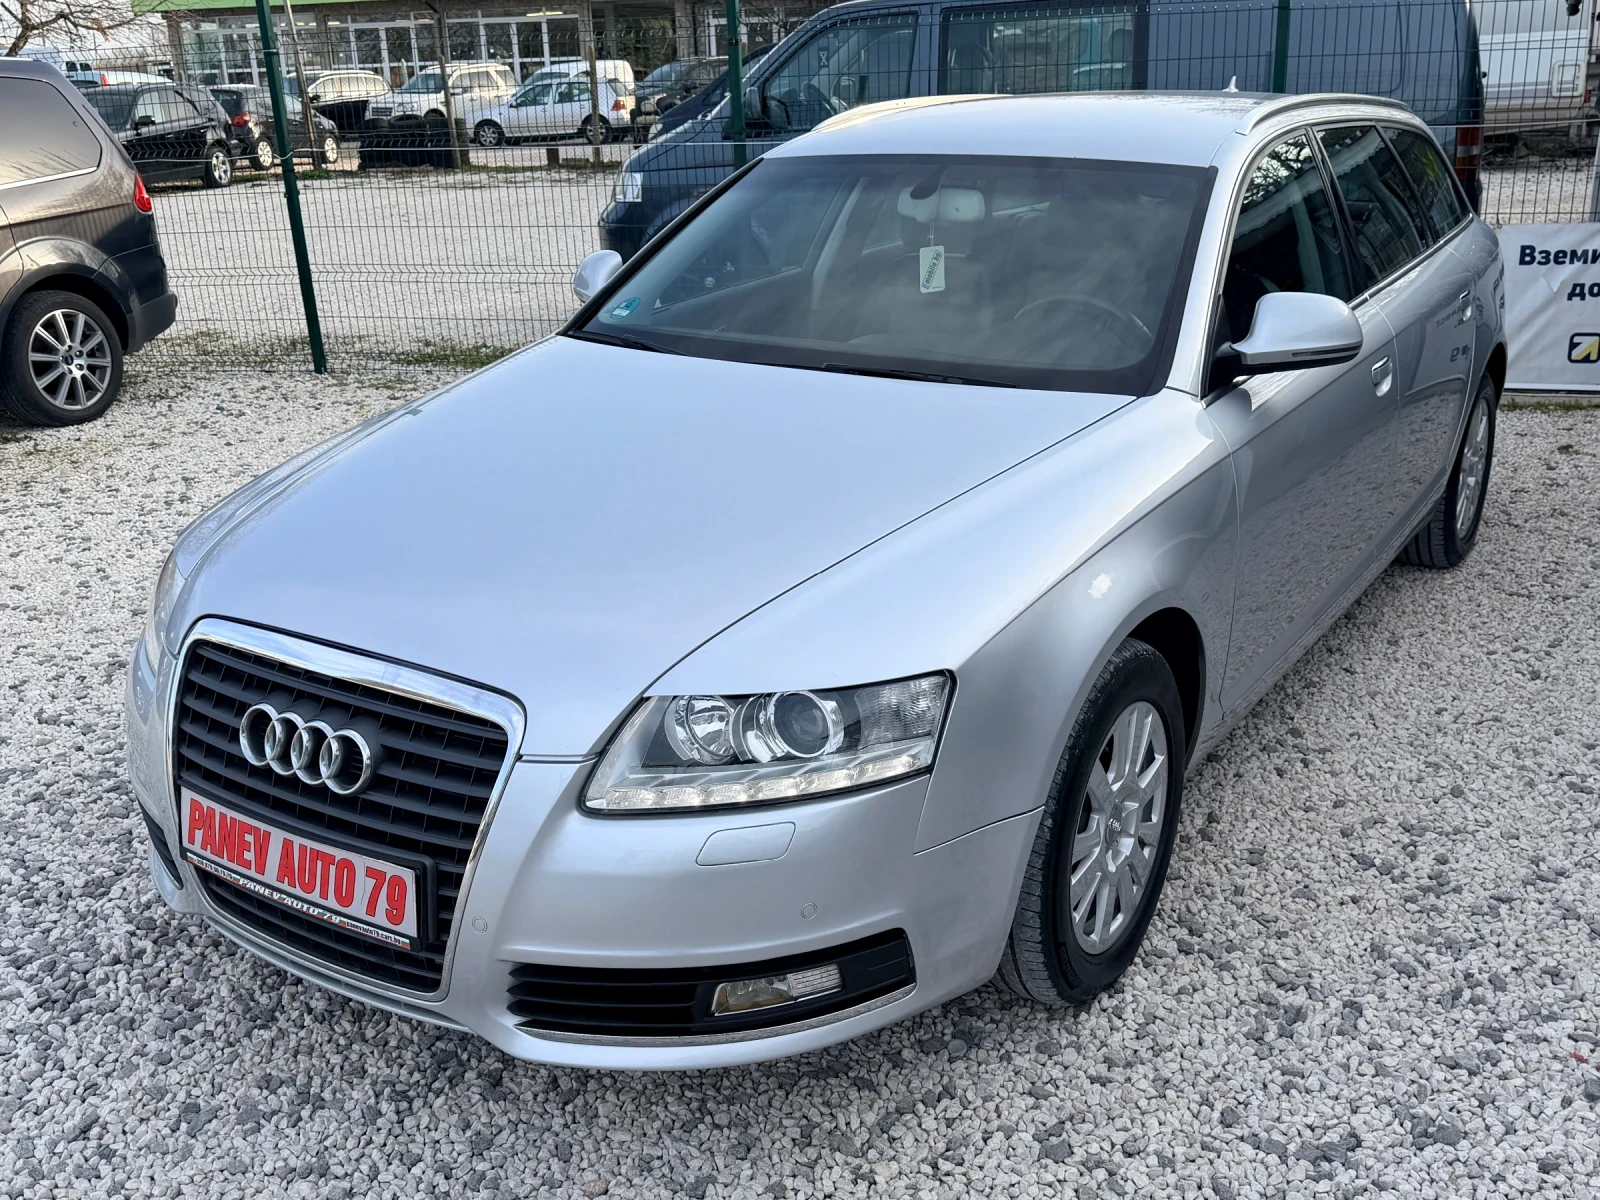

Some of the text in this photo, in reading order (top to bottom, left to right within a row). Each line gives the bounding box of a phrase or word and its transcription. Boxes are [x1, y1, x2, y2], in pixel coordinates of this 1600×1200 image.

[187, 797, 407, 926] PANEV AUTO 79
[239, 877, 340, 924] PANEV AUTO 79
